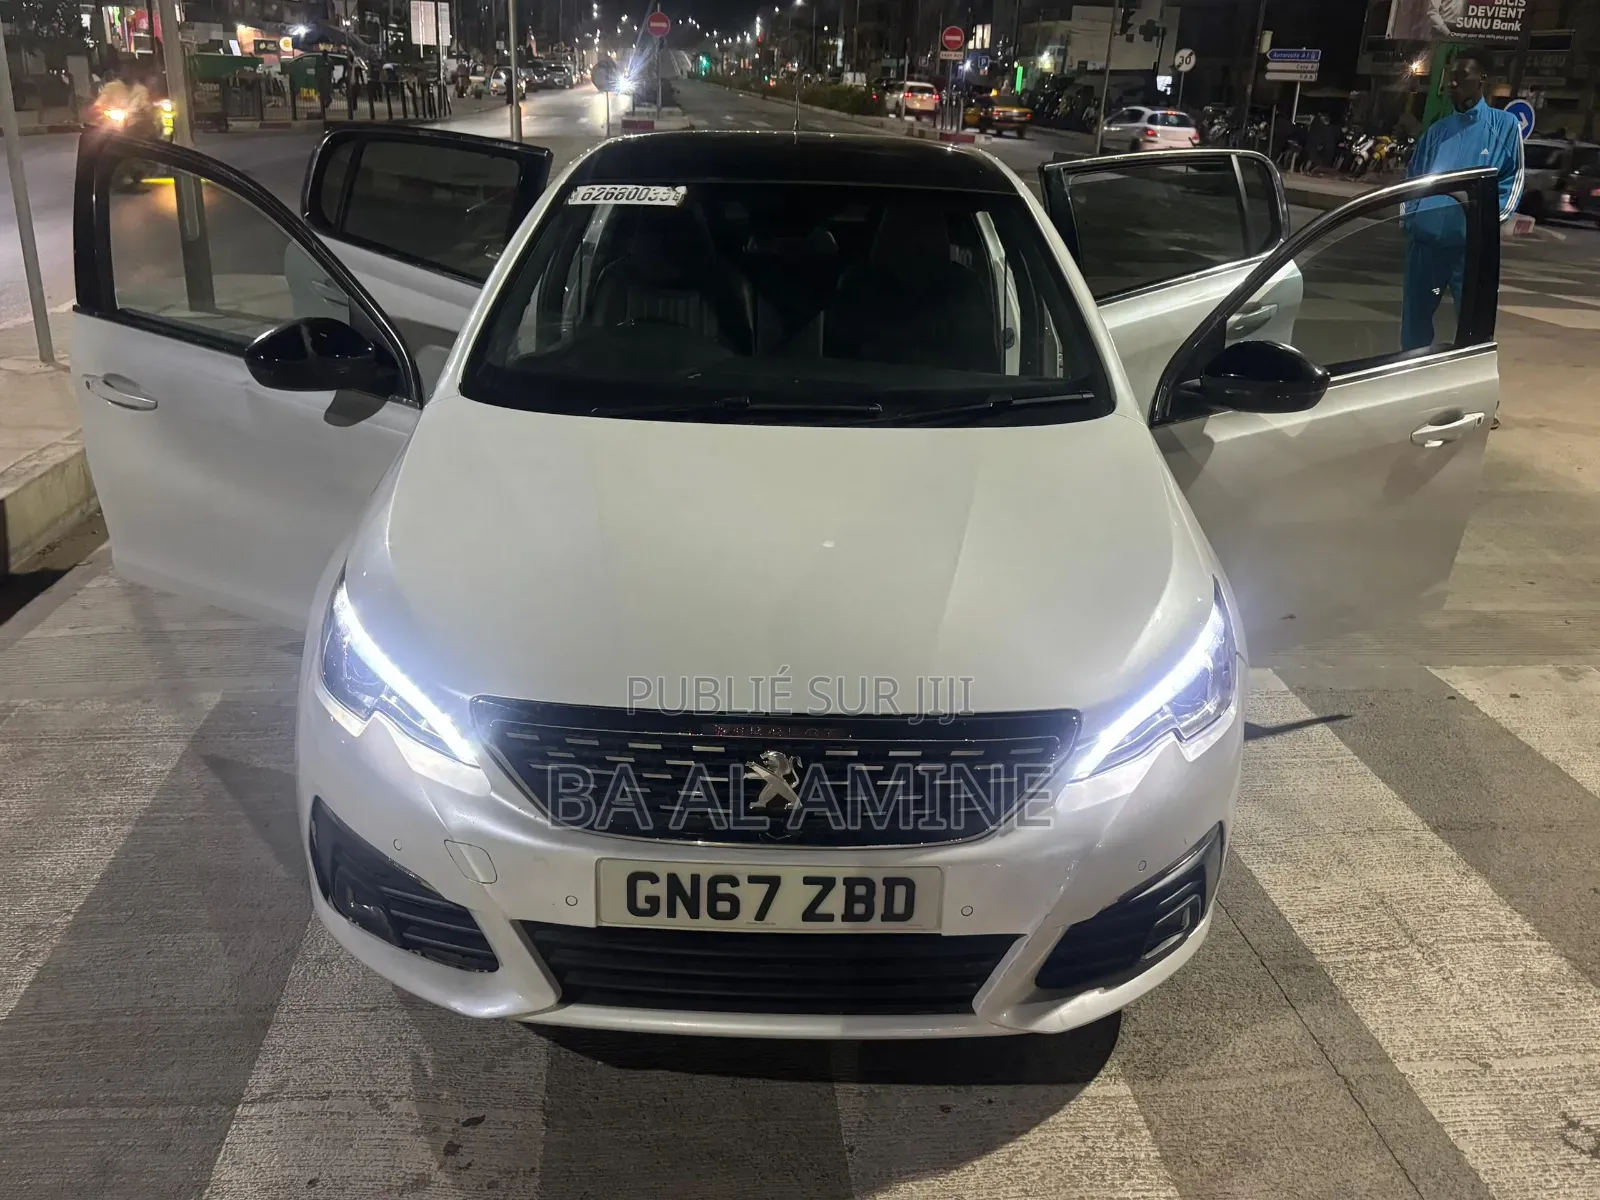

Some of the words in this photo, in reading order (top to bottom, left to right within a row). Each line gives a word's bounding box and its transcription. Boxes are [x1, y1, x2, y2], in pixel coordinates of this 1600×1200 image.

[1468, 5, 1525, 19] DEVIENT
[1456, 17, 1491, 29] SUNU
[1492, 19, 1522, 31] Bank
[1179, 55, 1191, 65] 30
[626, 871, 782, 921] GN67
[801, 876, 916, 923] ZBD
